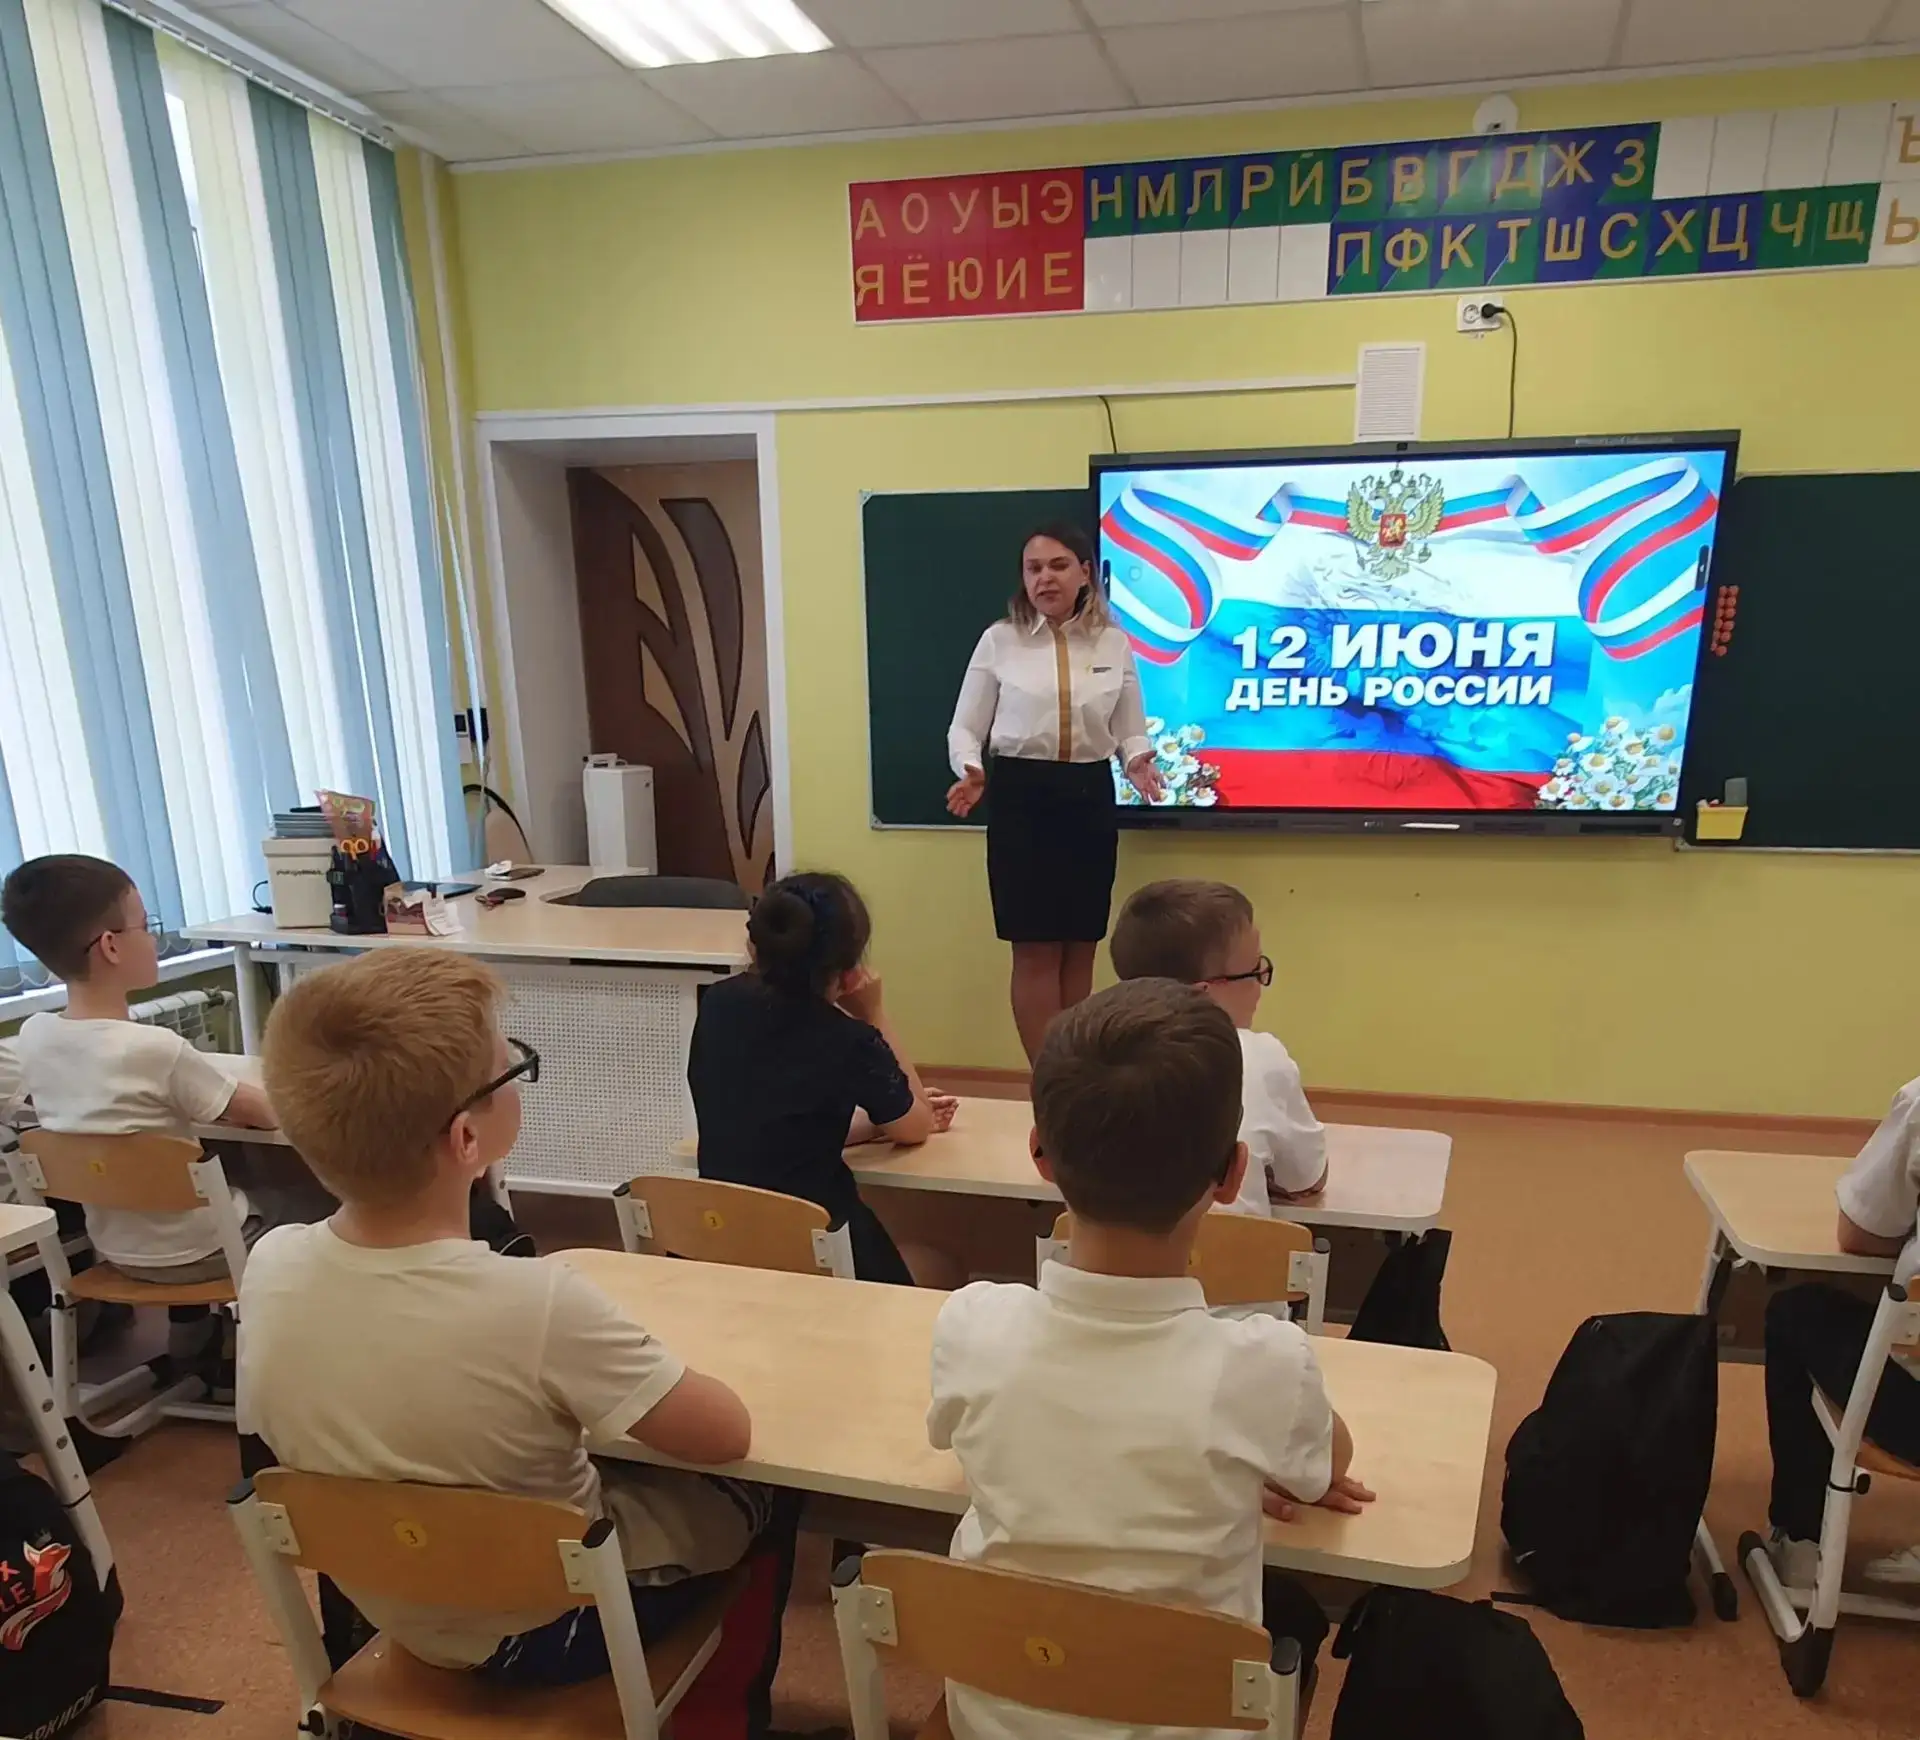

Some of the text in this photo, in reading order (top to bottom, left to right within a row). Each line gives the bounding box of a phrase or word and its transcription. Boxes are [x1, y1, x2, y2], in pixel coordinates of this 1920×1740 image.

[855, 199, 886, 241] А
[901, 192, 930, 234] О
[949, 189, 980, 235] У
[993, 185, 1028, 229] Ы
[1040, 180, 1073, 225] Э
[1091, 177, 1122, 221] Н
[1138, 172, 1175, 219] М
[1186, 169, 1223, 215] Л
[1241, 164, 1274, 210] Р
[1288, 150, 1324, 206] Й
[1340, 157, 1373, 206] Б
[1393, 156, 1424, 203] В
[1447, 149, 1476, 197] Г
[1493, 145, 1535, 201] Д
[1546, 140, 1595, 187] Ж
[1611, 139, 1645, 187] З
[1336, 198, 1920, 277] П Ф К Т Ш С Х Ц Ч Щ Ь
[856, 252, 1073, 307] Я Ё Ю И Е
[1232, 620, 1557, 670] 12 ИЮНЯ
[1225, 675, 1552, 712] ДЕНЬ РОССИИ
